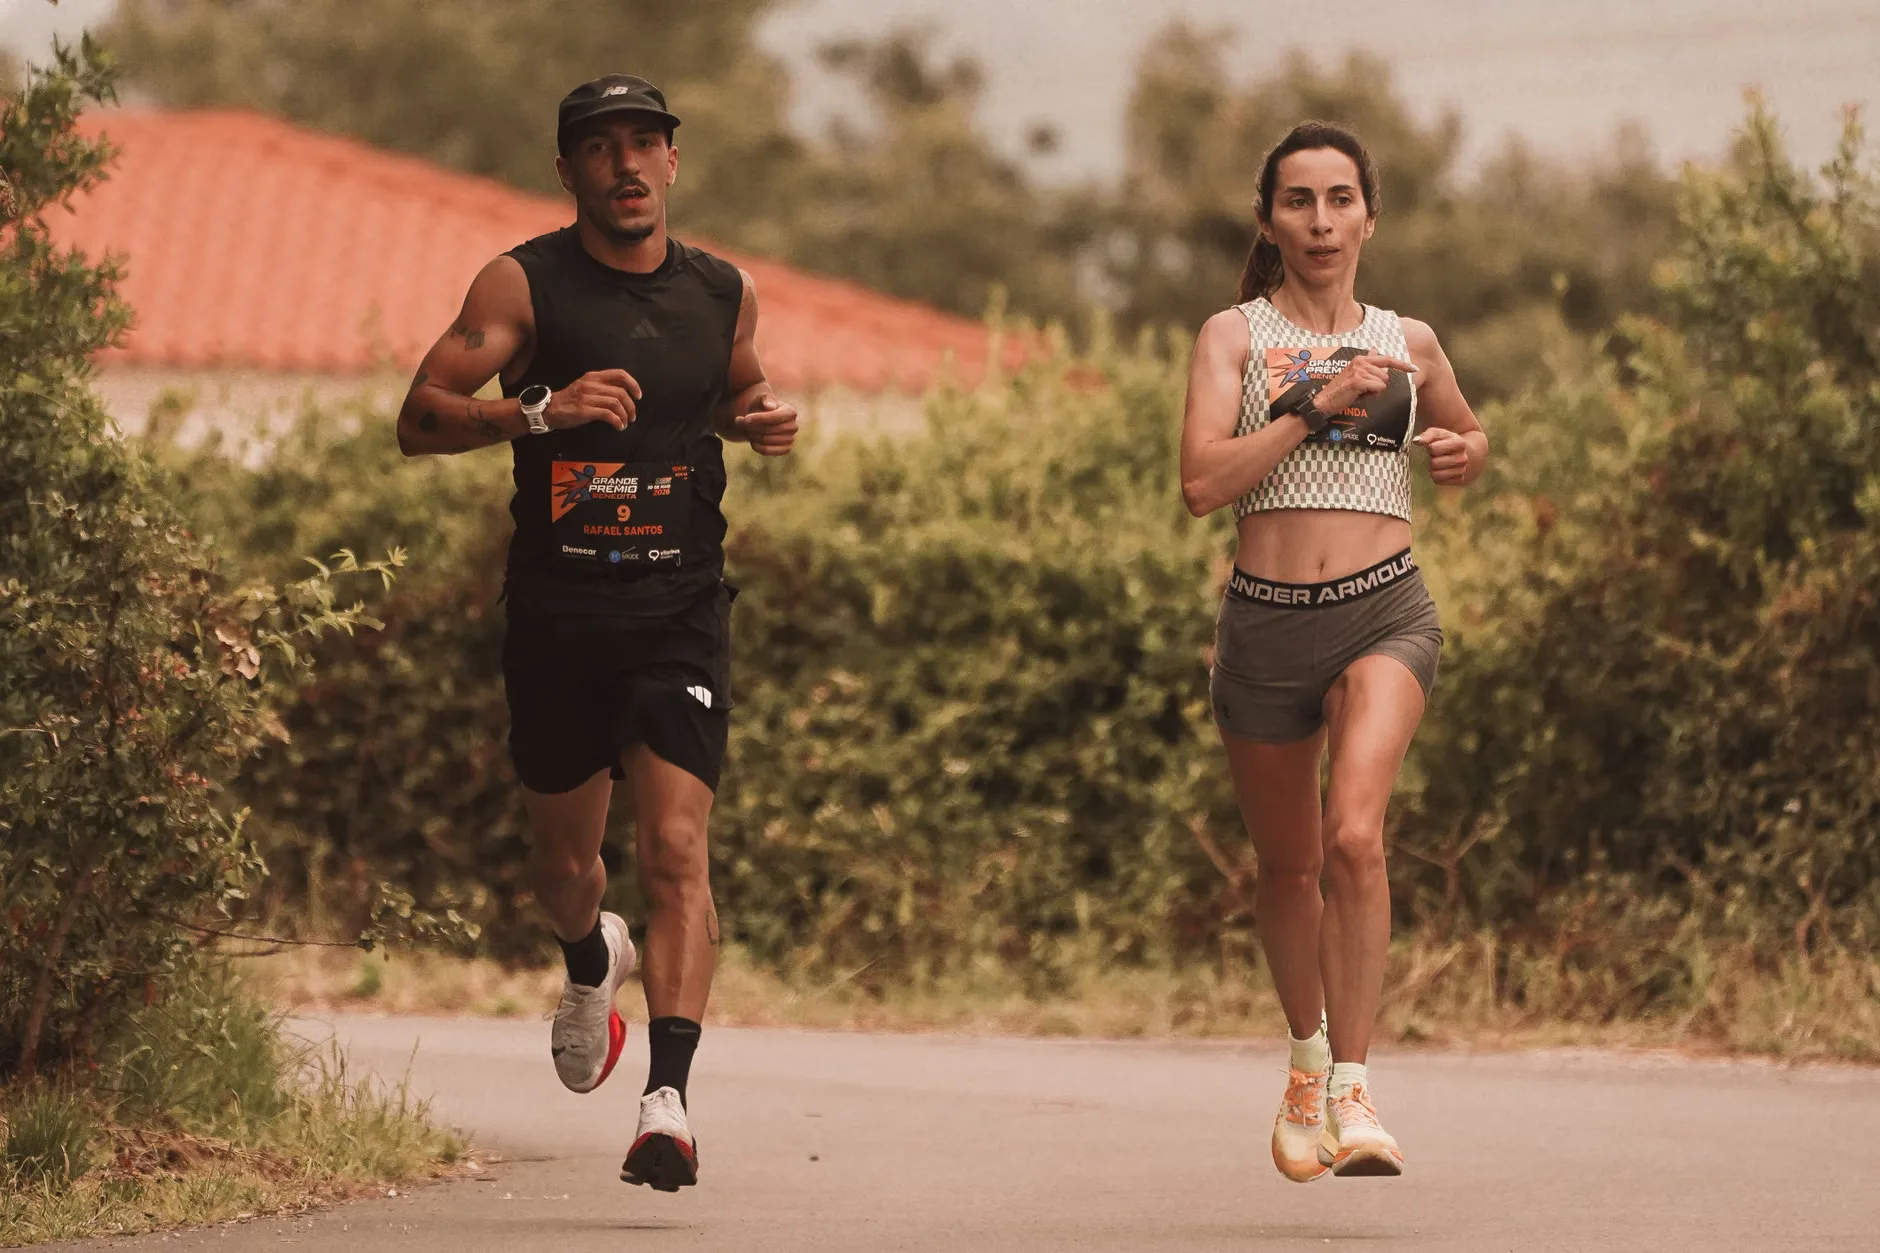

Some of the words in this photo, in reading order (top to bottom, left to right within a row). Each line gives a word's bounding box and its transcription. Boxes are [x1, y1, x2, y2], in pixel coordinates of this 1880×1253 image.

[1309, 359, 1352, 367] GRAND
[1305, 365, 1345, 374] PRÉM
[592, 477, 639, 485] GRANDE
[588, 483, 638, 493] PRÉMIO
[616, 504, 631, 521] 9
[583, 525, 622, 536] RAFAEL
[623, 525, 663, 536] SANTOS
[1230, 574, 1311, 605] UNDER
[1316, 552, 1415, 604] ARMOUR
